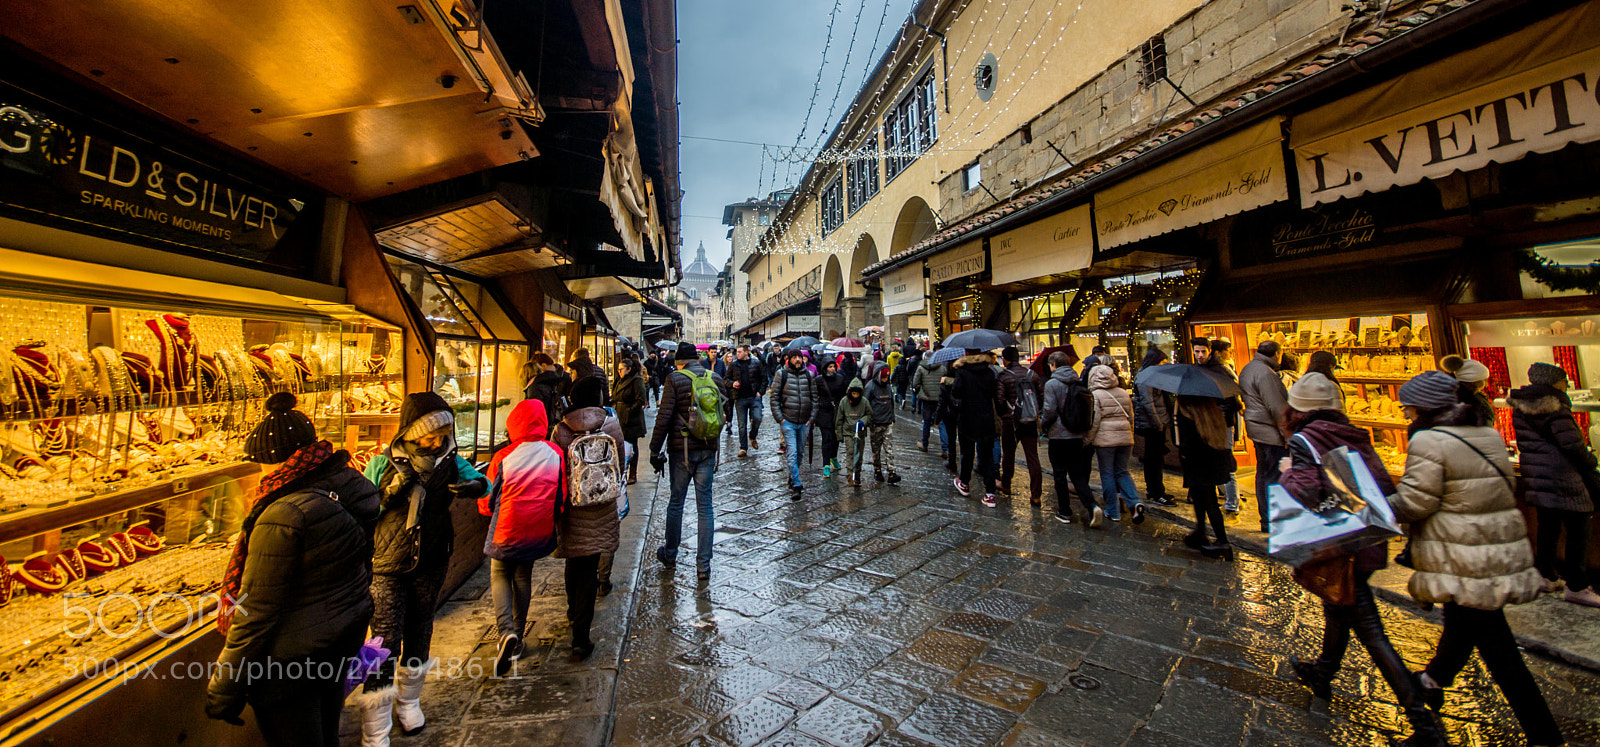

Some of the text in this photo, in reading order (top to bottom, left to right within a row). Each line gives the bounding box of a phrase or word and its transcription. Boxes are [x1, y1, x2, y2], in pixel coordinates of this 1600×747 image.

[1364, 72, 1600, 174] VETT
[0, 106, 279, 240] GOLD & SILVER
[80, 190, 233, 241] SPARKLING MOMENTS
[1053, 224, 1081, 242] Cartier
[1101, 221, 1125, 236] Ponte
[1123, 209, 1158, 229] Vecchio
[1272, 208, 1374, 243] Ponte Vecchio
[931, 255, 985, 282] CARLO PICCINI
